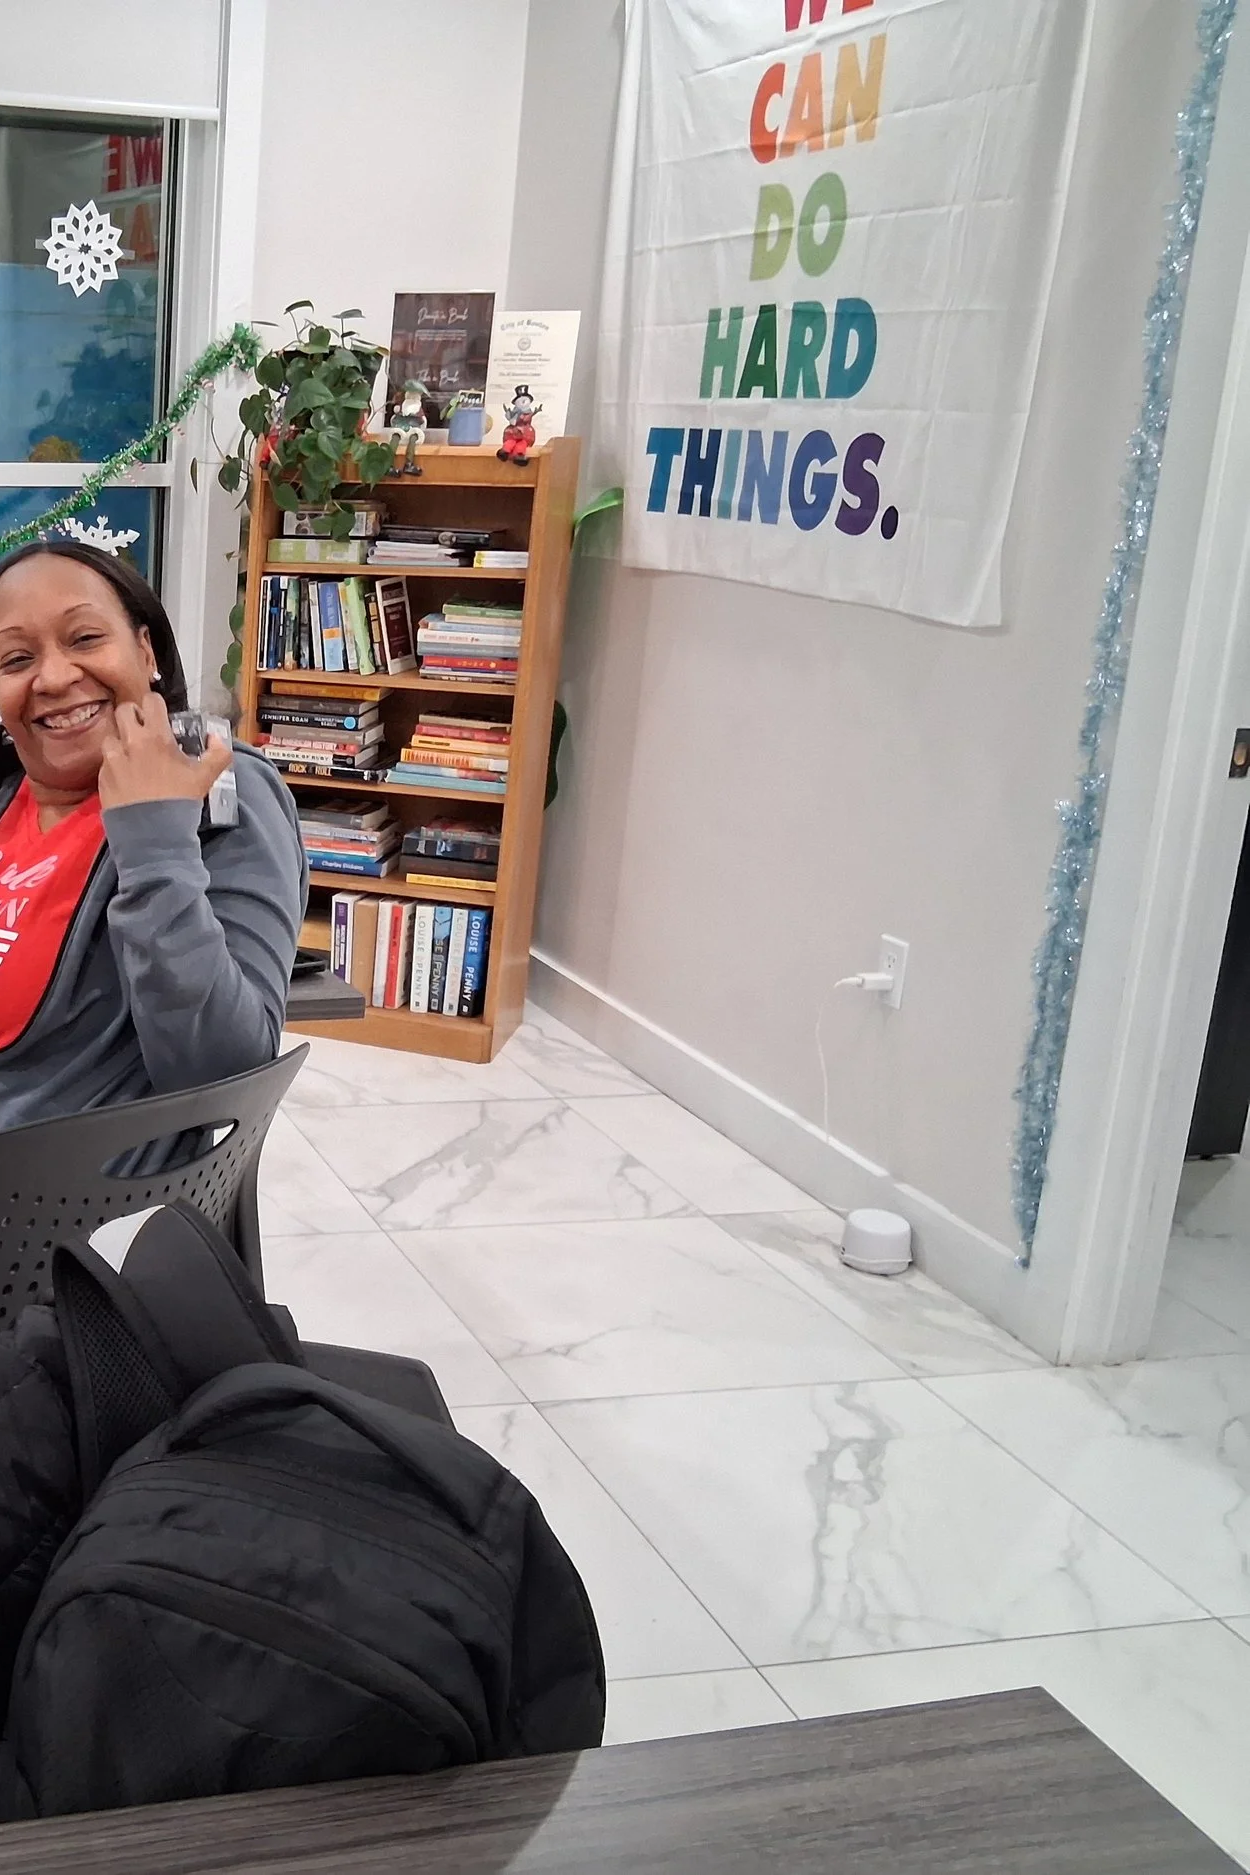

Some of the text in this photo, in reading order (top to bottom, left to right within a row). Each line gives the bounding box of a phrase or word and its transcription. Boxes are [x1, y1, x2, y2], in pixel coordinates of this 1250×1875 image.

[750, 34, 887, 164] CAN
[749, 172, 847, 281] DO
[699, 298, 877, 399] HARD
[646, 427, 899, 540] THINGS.
[261, 712, 290, 722] JENNIFER
[288, 762, 308, 774] ROCK
[414, 915, 427, 998] LOUISE PENNY
[430, 962, 443, 1000] PENNY
[462, 915, 483, 1001] LOUISE PENNY
